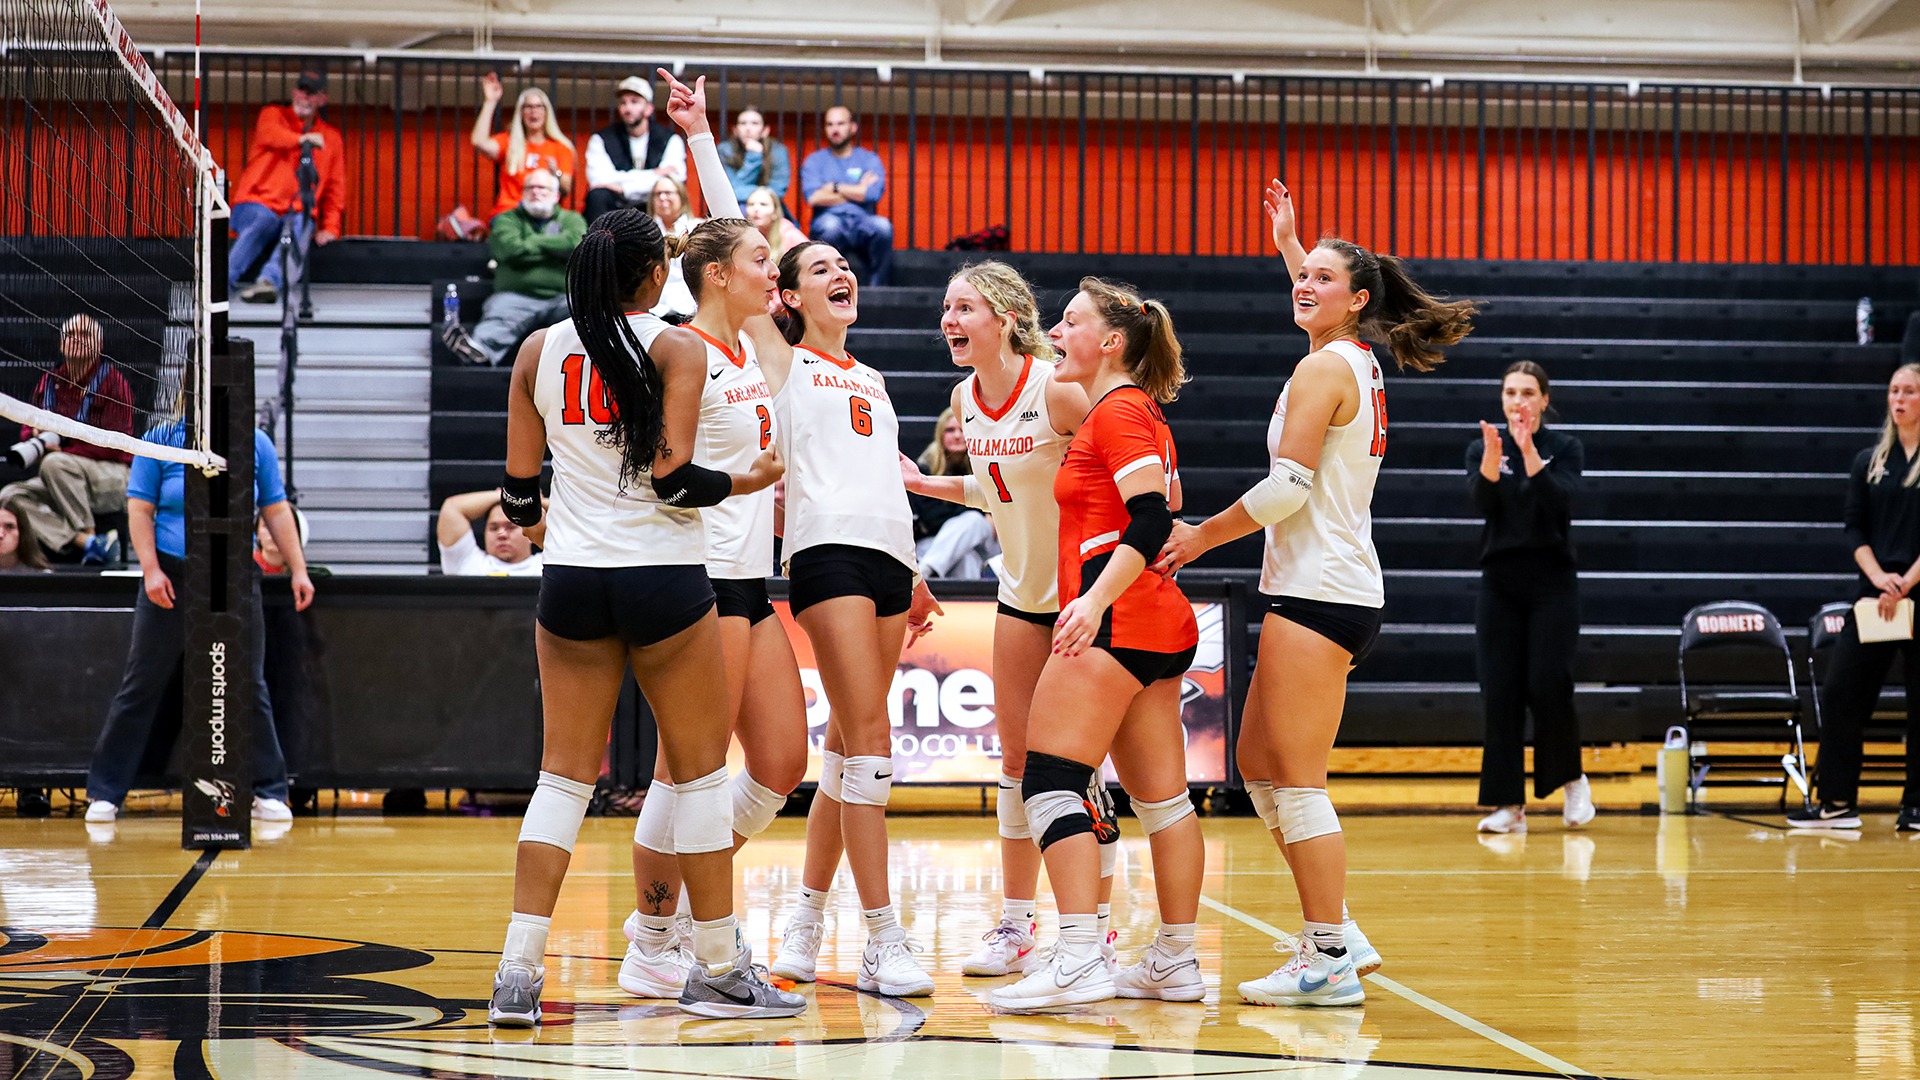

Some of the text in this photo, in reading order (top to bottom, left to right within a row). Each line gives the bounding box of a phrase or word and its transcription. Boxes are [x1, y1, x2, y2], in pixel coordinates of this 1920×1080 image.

[756, 404, 771, 450] 2
[849, 395, 873, 437] 6
[967, 436, 1034, 456] KALAMAZOO
[988, 462, 1013, 503] 1
[1696, 614, 1766, 633] HORNETS
[209, 642, 227, 765] sports imports
